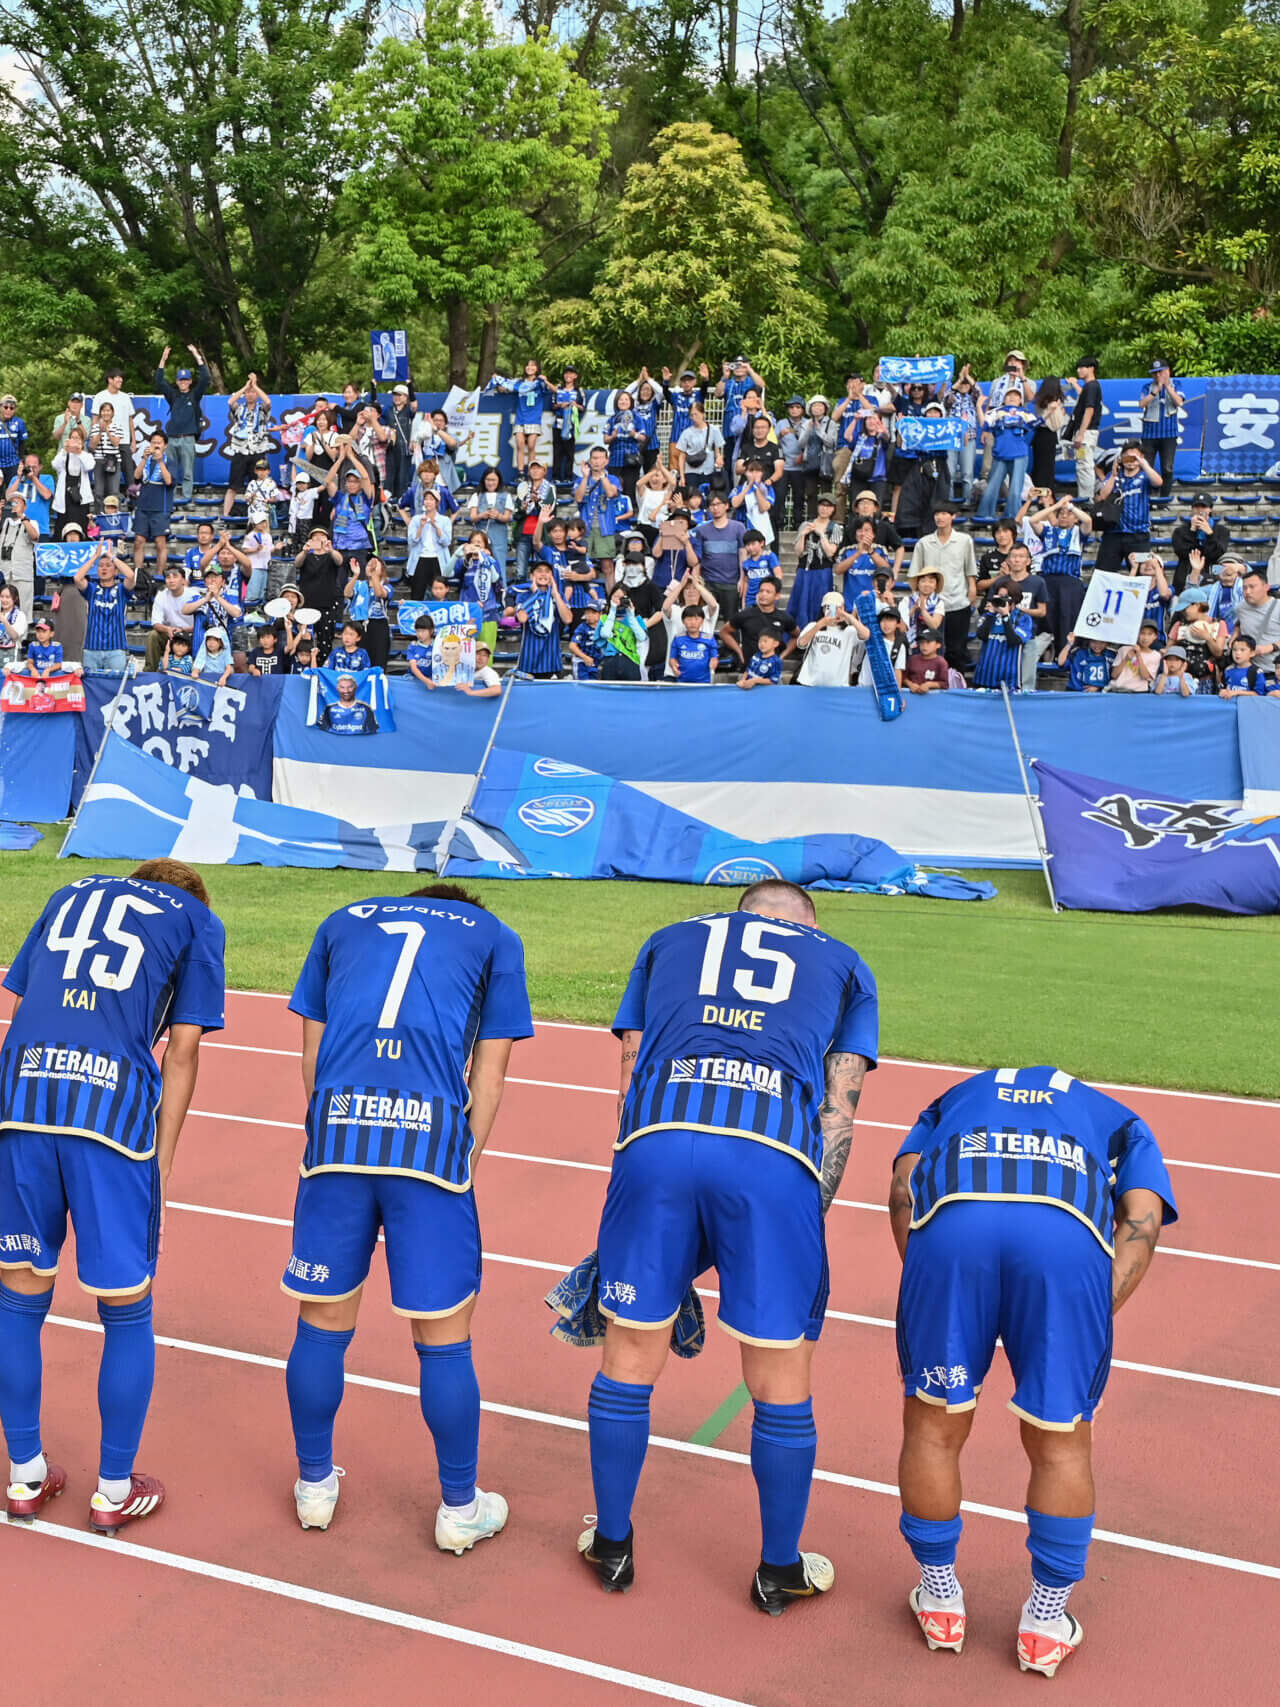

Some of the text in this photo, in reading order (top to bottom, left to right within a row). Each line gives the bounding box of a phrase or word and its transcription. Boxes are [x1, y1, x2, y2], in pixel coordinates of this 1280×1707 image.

[1217, 393, 1279, 450] 安
[1103, 589, 1124, 615] 11
[1090, 666, 1104, 681] 26
[100, 682, 248, 743] PRIE
[887, 697, 895, 712] 7
[46, 888, 165, 992] 45
[376, 920, 427, 1029] 7
[697, 915, 806, 1005] 15
[61, 988, 97, 1011] KAI
[702, 1004, 766, 1032] DUKE
[375, 1038, 402, 1060] YU
[45, 1048, 119, 1083] TERADA
[699, 1058, 783, 1092] TERADA
[88, 1075, 117, 1091] TOKYO
[997, 1086, 1054, 1105] ERIK
[353, 1094, 433, 1124] TERADA
[400, 1120, 432, 1132] TOKYO
[990, 1132, 1087, 1168] TERADA
